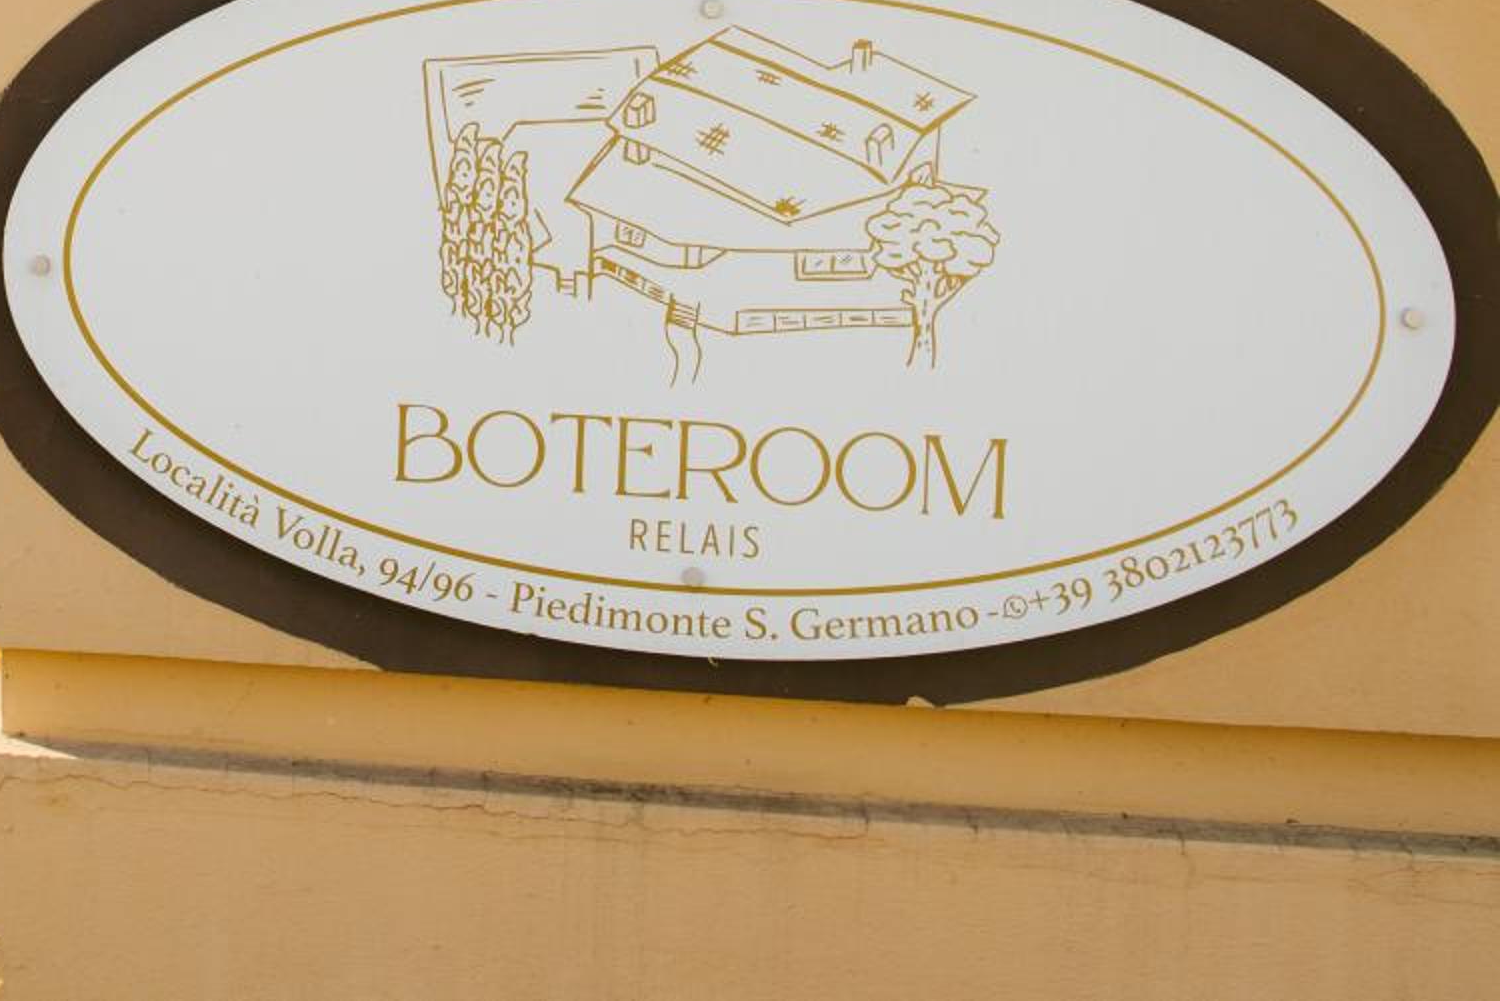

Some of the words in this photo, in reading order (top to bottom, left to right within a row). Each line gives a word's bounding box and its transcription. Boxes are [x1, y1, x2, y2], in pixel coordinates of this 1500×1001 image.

[394, 402, 1008, 520] BOTEROOM
[131, 428, 262, 529] Località
[275, 502, 366, 577] Volla,
[379, 556, 475, 603] 94/96
[510, 581, 731, 639] Piedimonte
[744, 607, 778, 641] S.
[790, 606, 980, 643] Germano
[1103, 498, 1299, 604] 3802123773
[629, 518, 761, 559] RELAIS
